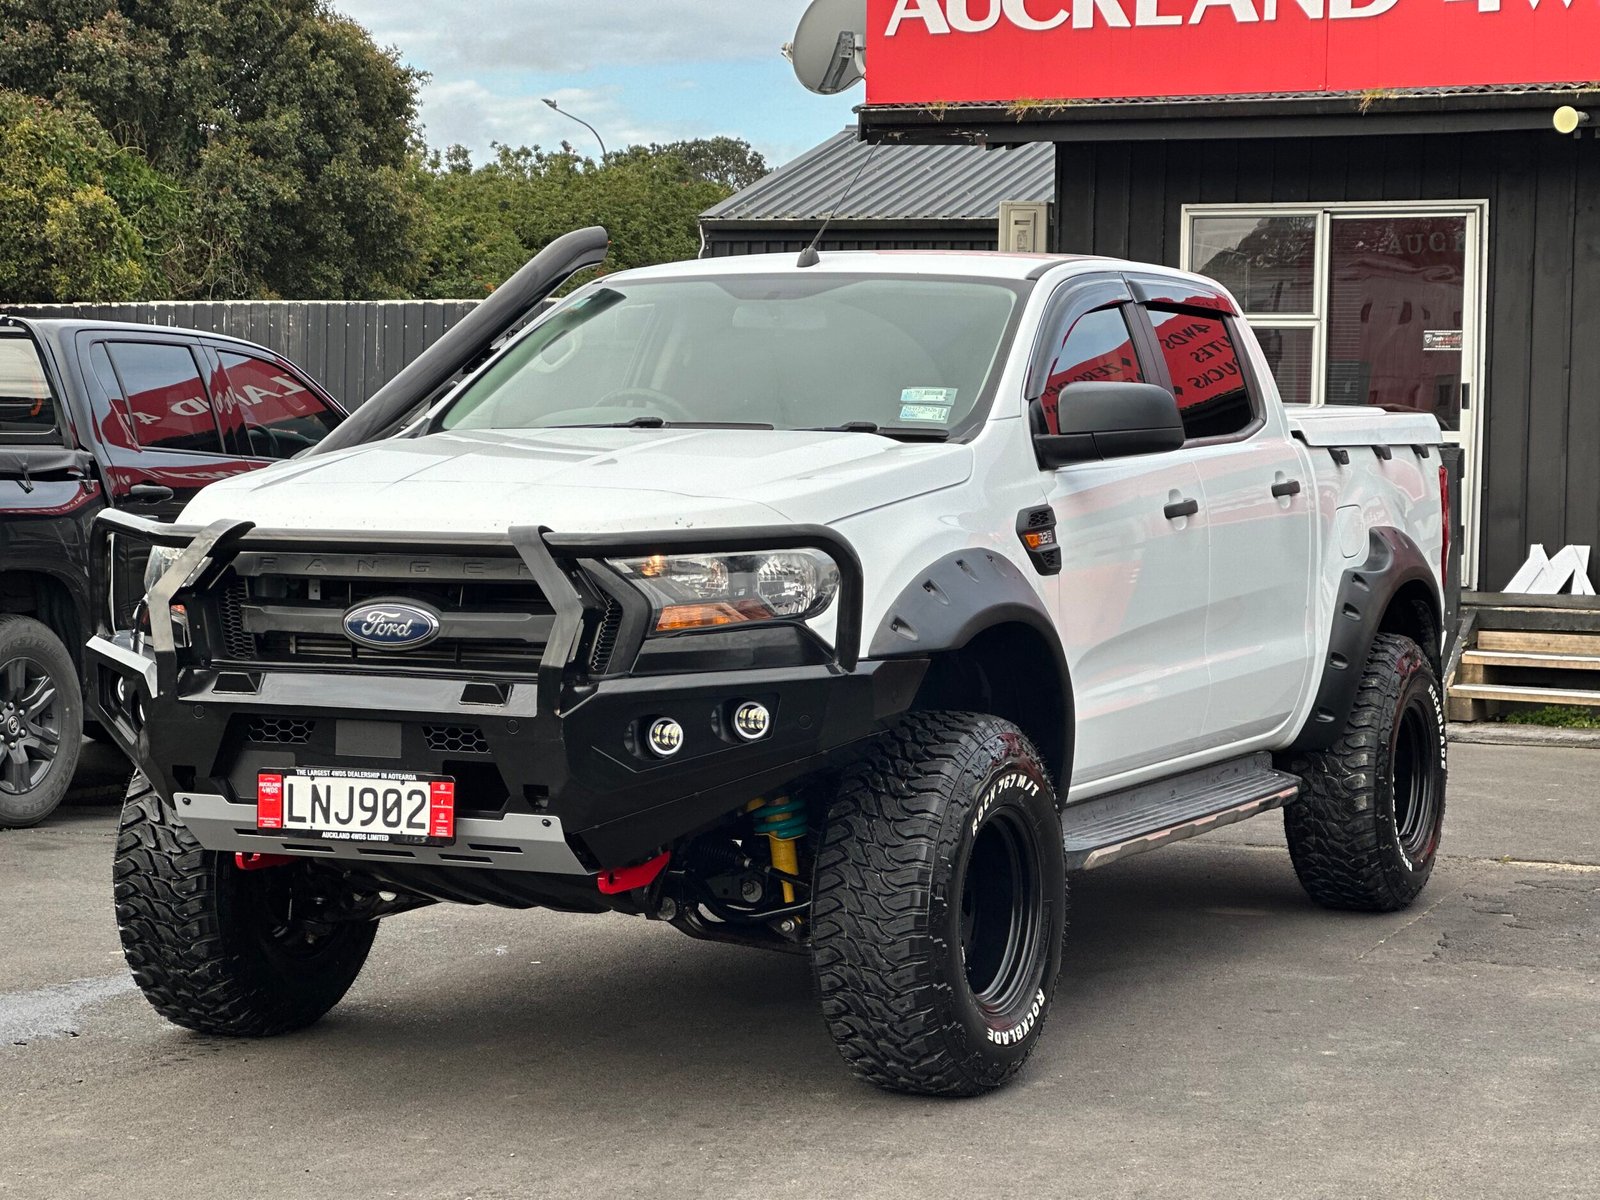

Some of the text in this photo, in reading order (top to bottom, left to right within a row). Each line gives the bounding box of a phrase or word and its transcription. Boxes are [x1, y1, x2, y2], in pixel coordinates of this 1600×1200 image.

[360, 610, 413, 638] Ford
[1428, 683, 1447, 770] ROCKBLADE
[307, 769, 331, 777] LARGEST
[347, 771, 380, 779] DEALERSHIP
[388, 772, 417, 781] AOTEAROA
[1016, 774, 1040, 797] M/T
[287, 783, 427, 830] LNJ902
[321, 831, 350, 840] AUCKLAND
[351, 832, 367, 840] 4WDS
[367, 833, 390, 842] LIMITED
[986, 987, 1046, 1046] ROCKBLADE
